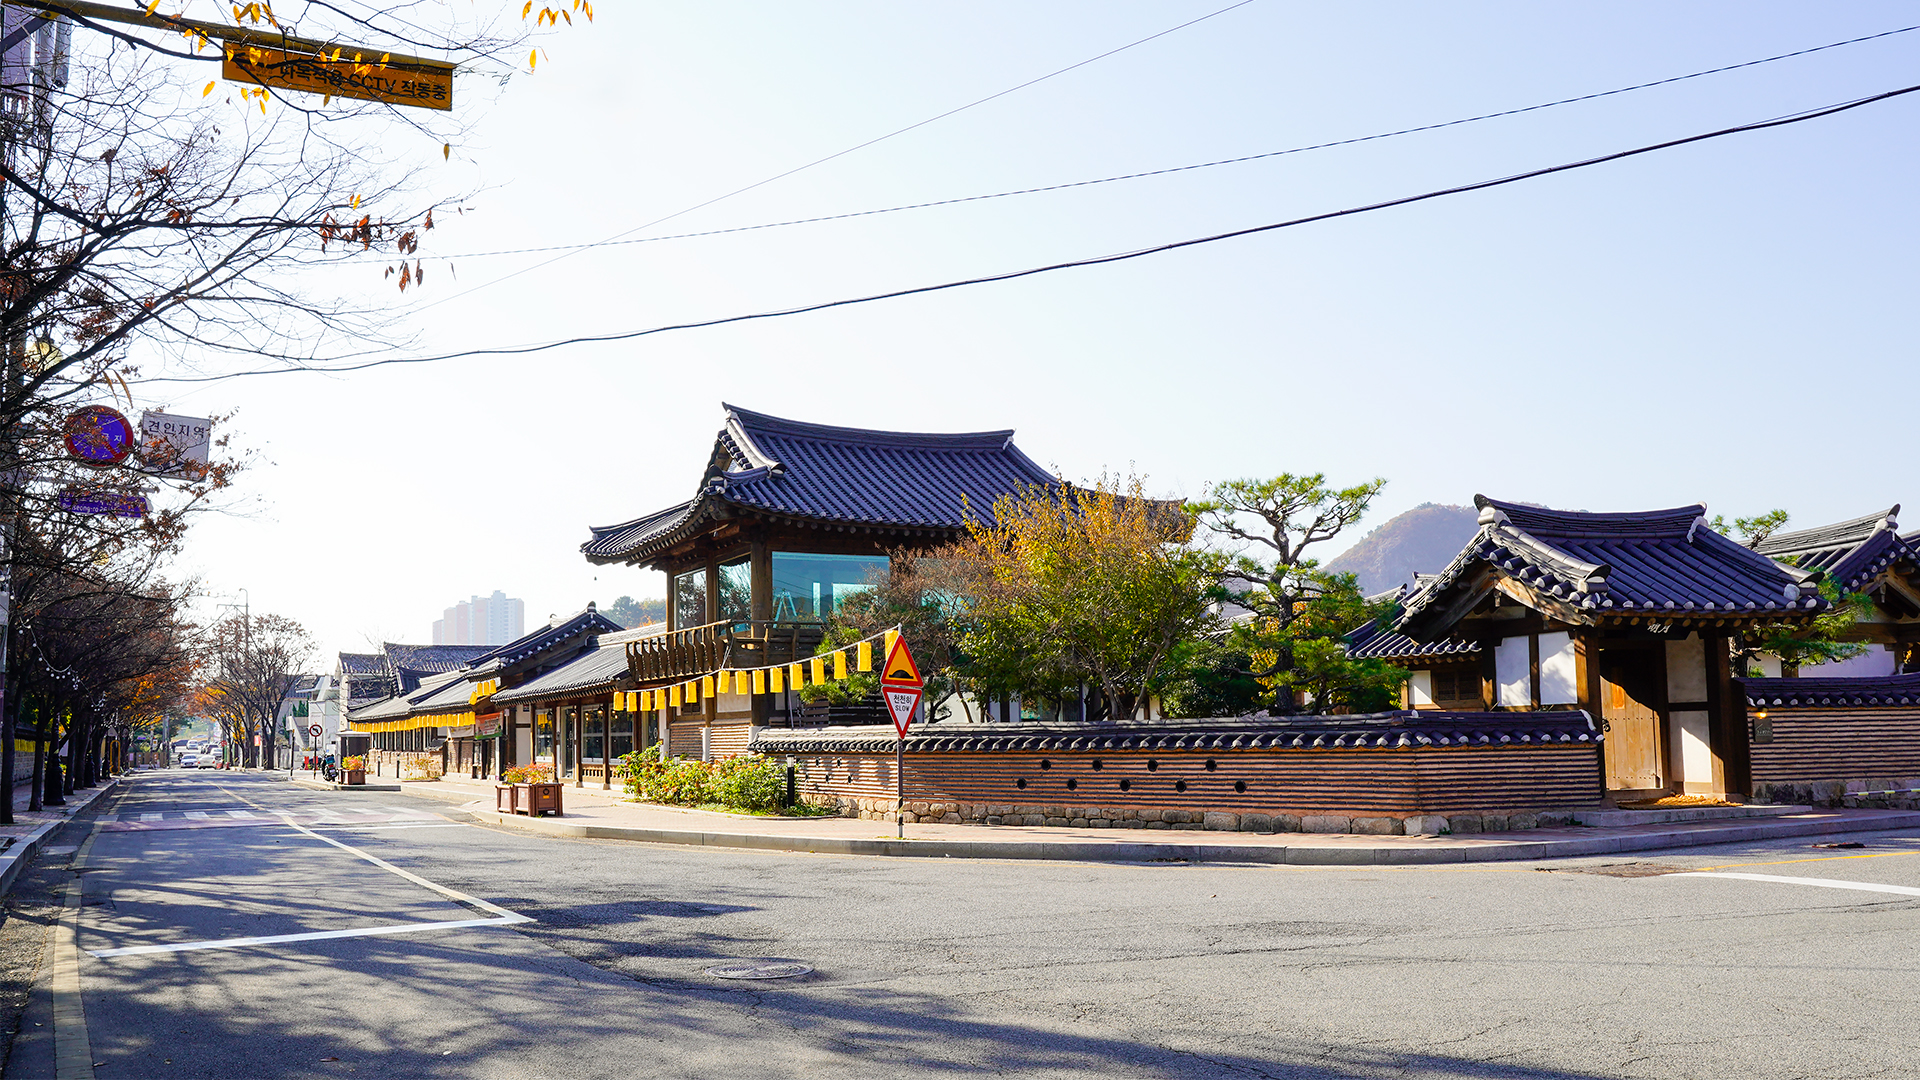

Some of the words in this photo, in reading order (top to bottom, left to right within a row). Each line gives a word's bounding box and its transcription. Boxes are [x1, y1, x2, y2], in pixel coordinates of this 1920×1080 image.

[348, 73, 397, 92] CCTV
[401, 80, 447, 100] 작동중
[148, 420, 205, 438] 견인지역
[893, 694, 912, 705] 천천히
